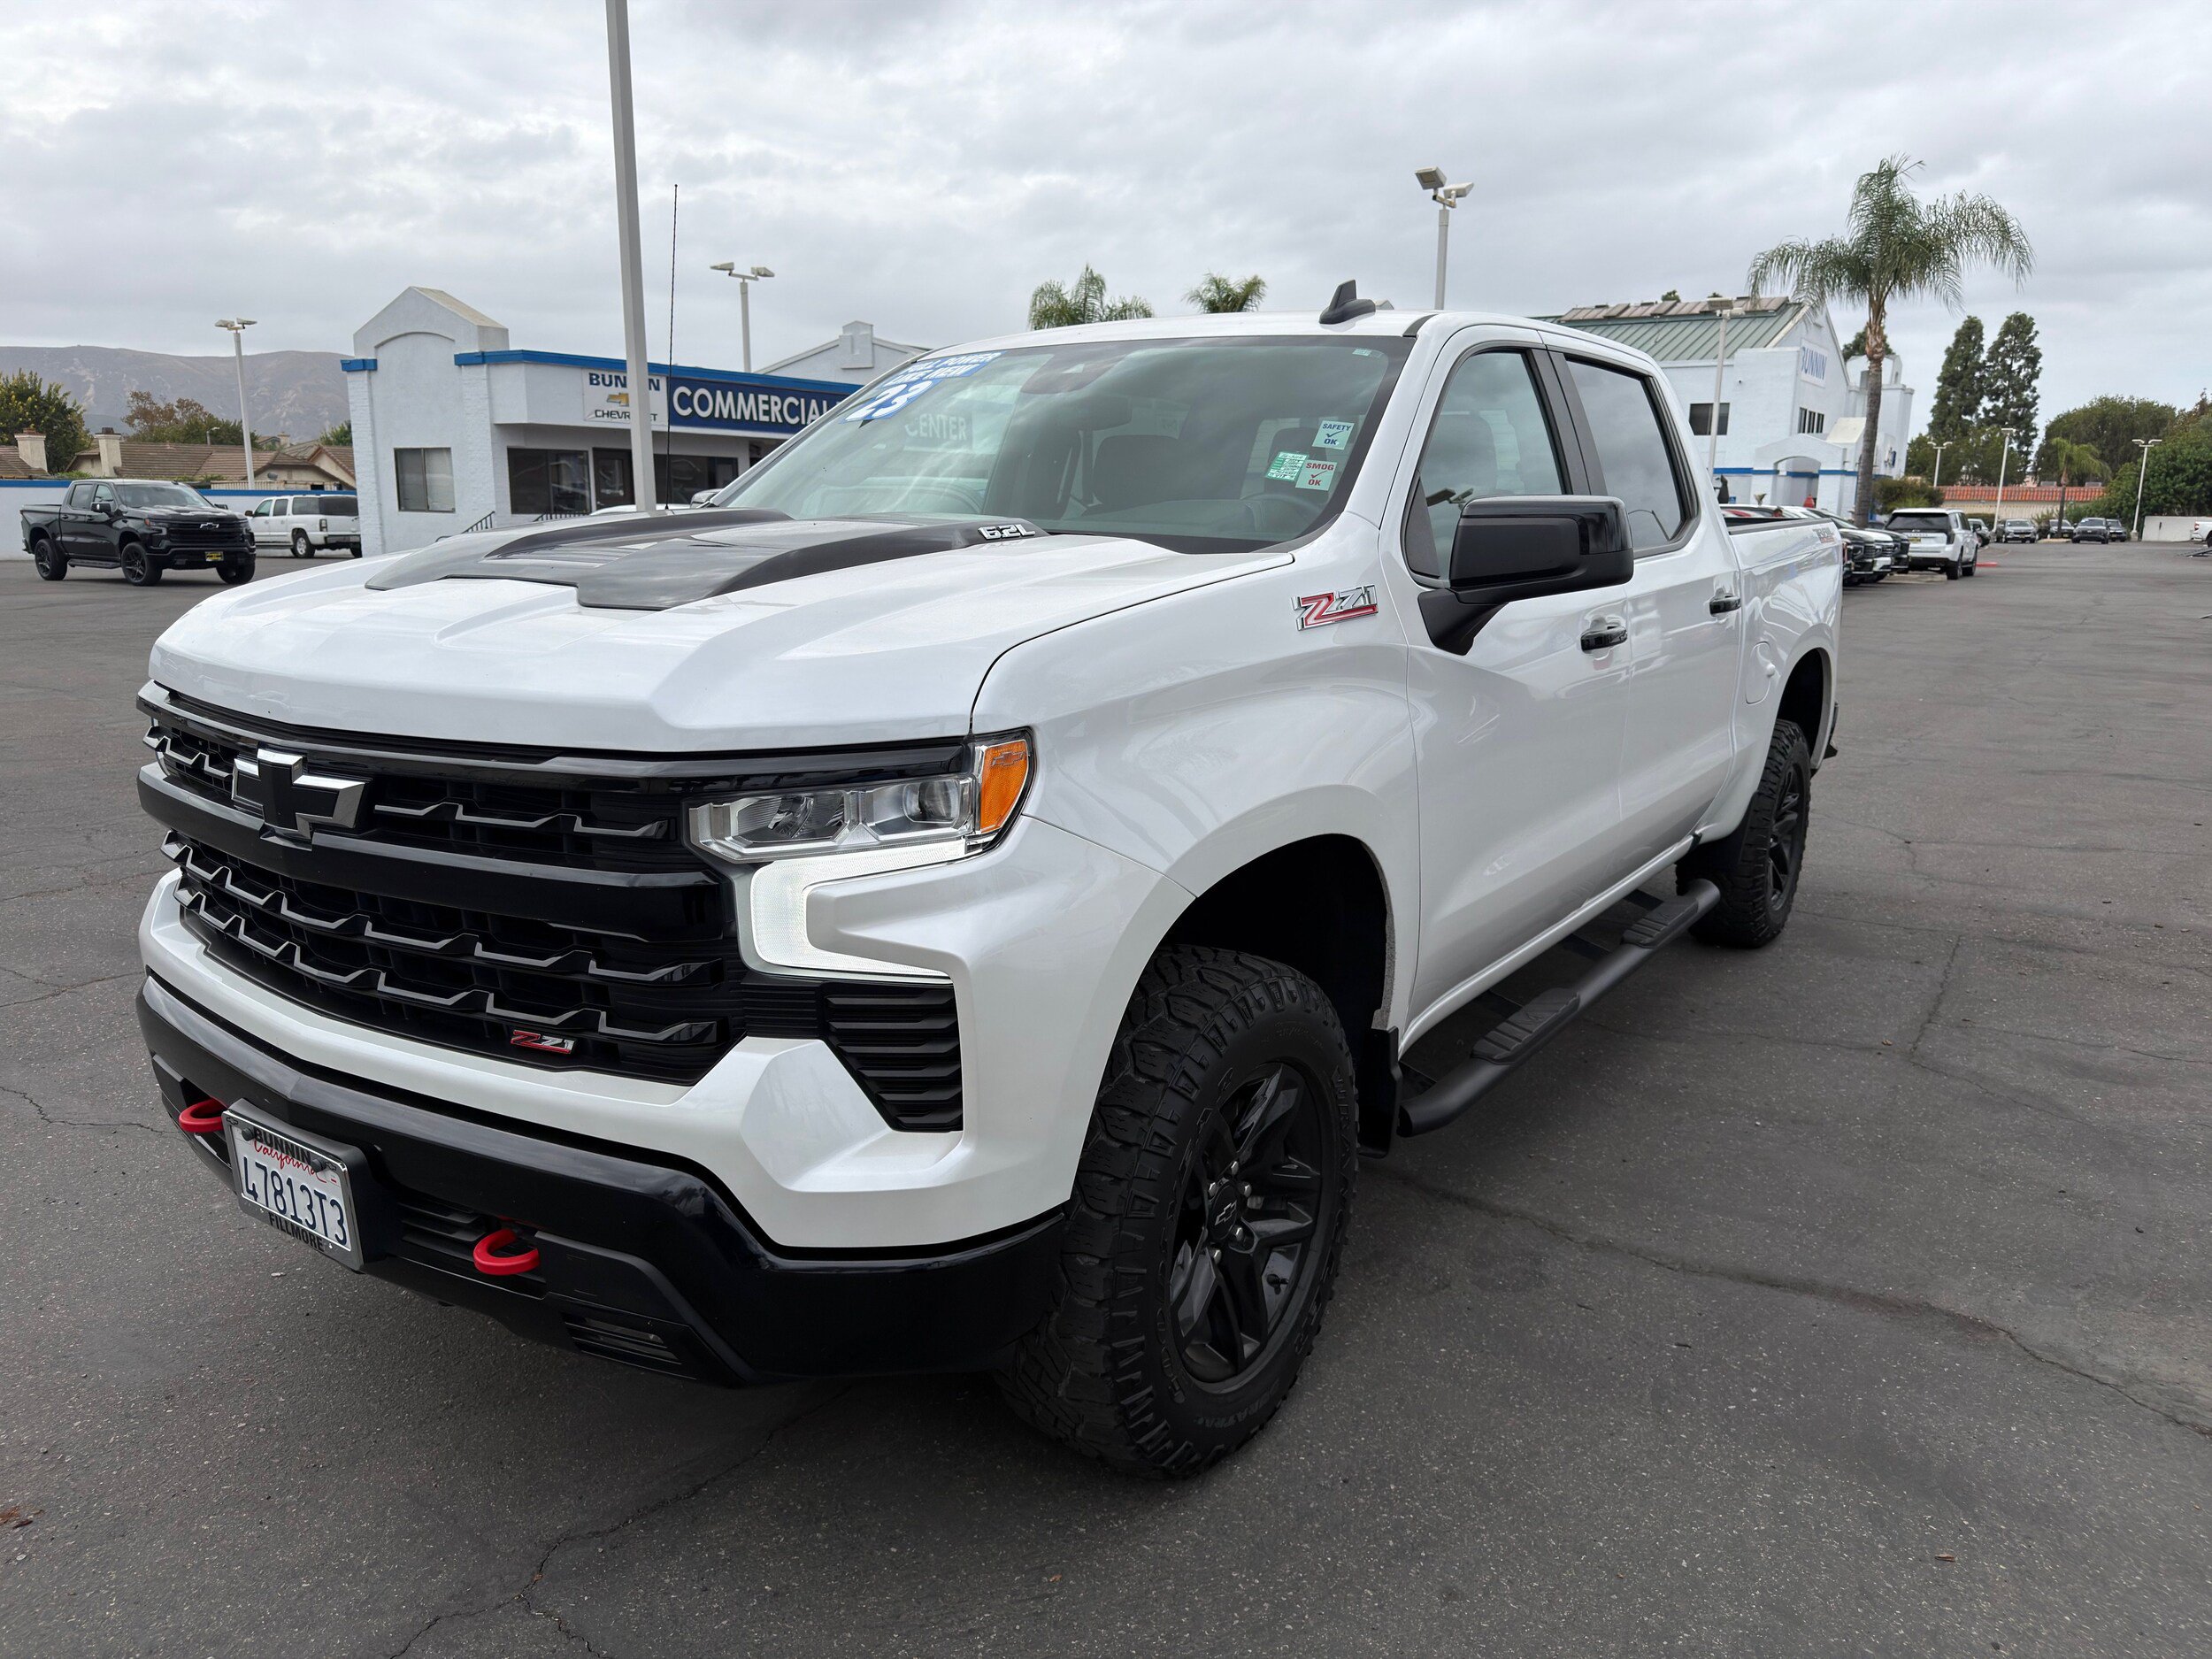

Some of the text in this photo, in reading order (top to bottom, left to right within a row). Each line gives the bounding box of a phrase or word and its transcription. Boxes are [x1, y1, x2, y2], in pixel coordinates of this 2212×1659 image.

[588, 372, 661, 391] BUNN
[845, 380, 933, 422] 23
[595, 409, 658, 422] CHEVRT
[904, 414, 968, 441] CENTER
[1322, 423, 1352, 432] SAFETY
[1306, 462, 1334, 471] SMOG
[1291, 584, 1379, 631] Z71
[511, 1029, 576, 1055] Z71
[253, 1125, 311, 1165] BUNNIN
[242, 1156, 348, 1247] 47813T3
[268, 1211, 326, 1253] FILLMORE
